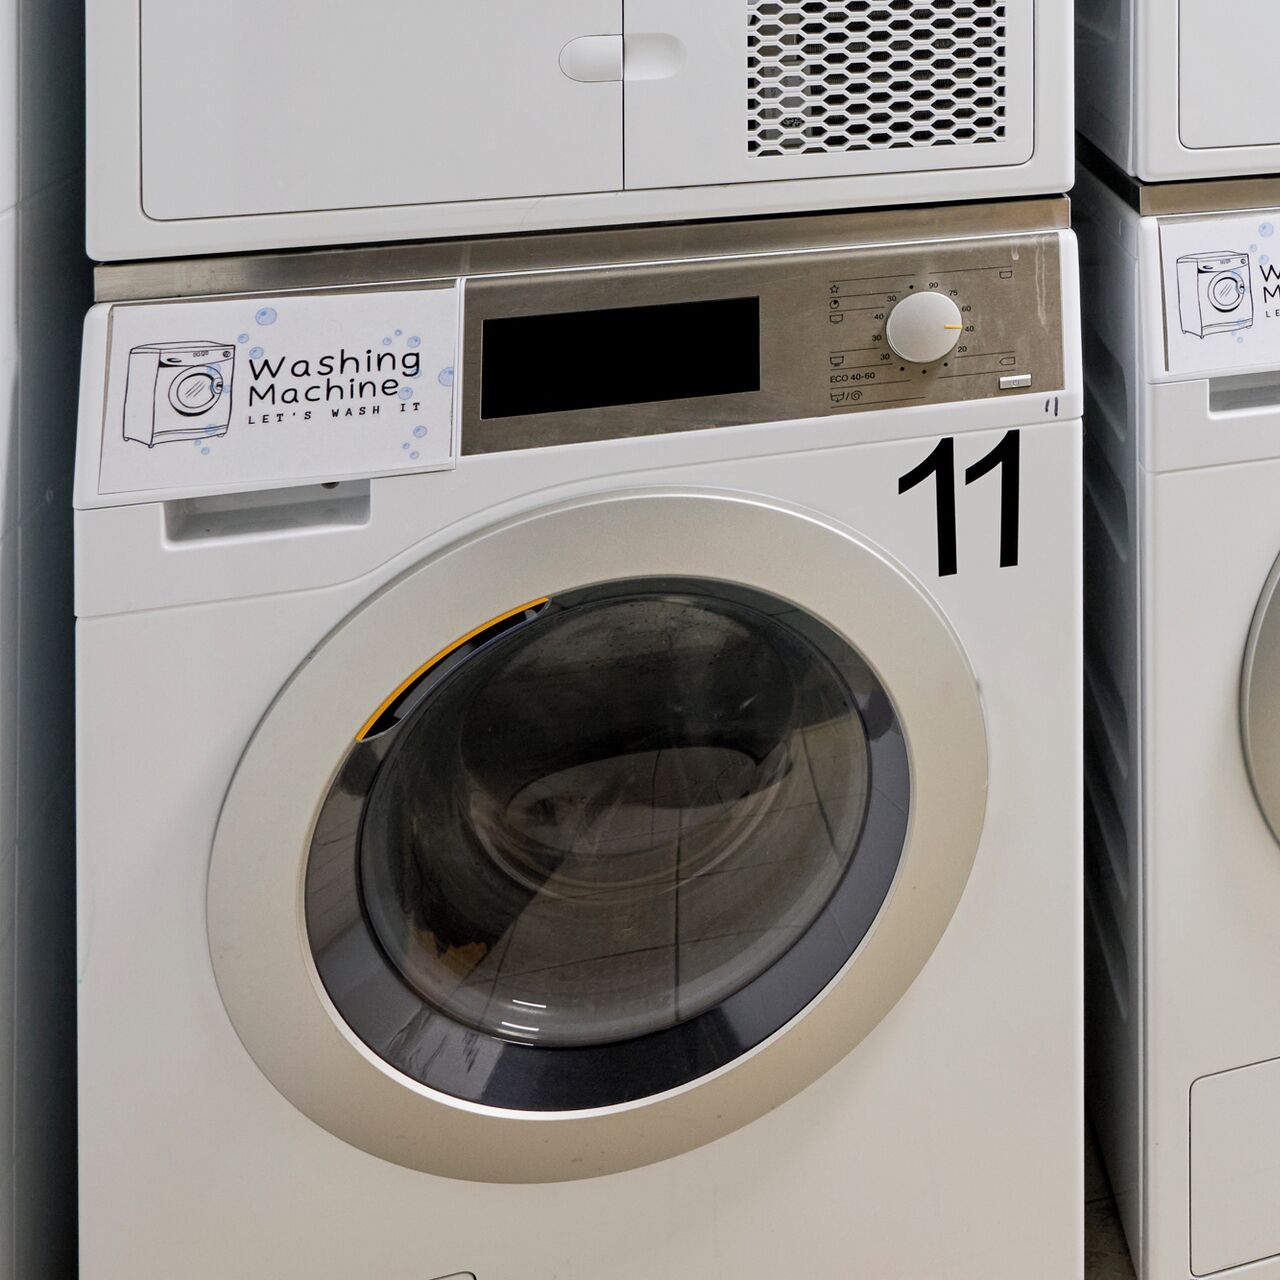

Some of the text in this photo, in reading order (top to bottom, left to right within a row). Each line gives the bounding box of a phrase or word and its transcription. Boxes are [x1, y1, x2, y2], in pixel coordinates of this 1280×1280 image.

[965, 325, 975, 333] 40
[249, 349, 421, 380] Washing
[880, 353, 890, 361] 30
[830, 372, 875, 383] ECO 40-60
[249, 378, 399, 407] Machine
[248, 402, 421, 424] LET'S WASH IT
[898, 429, 1020, 577] 11
